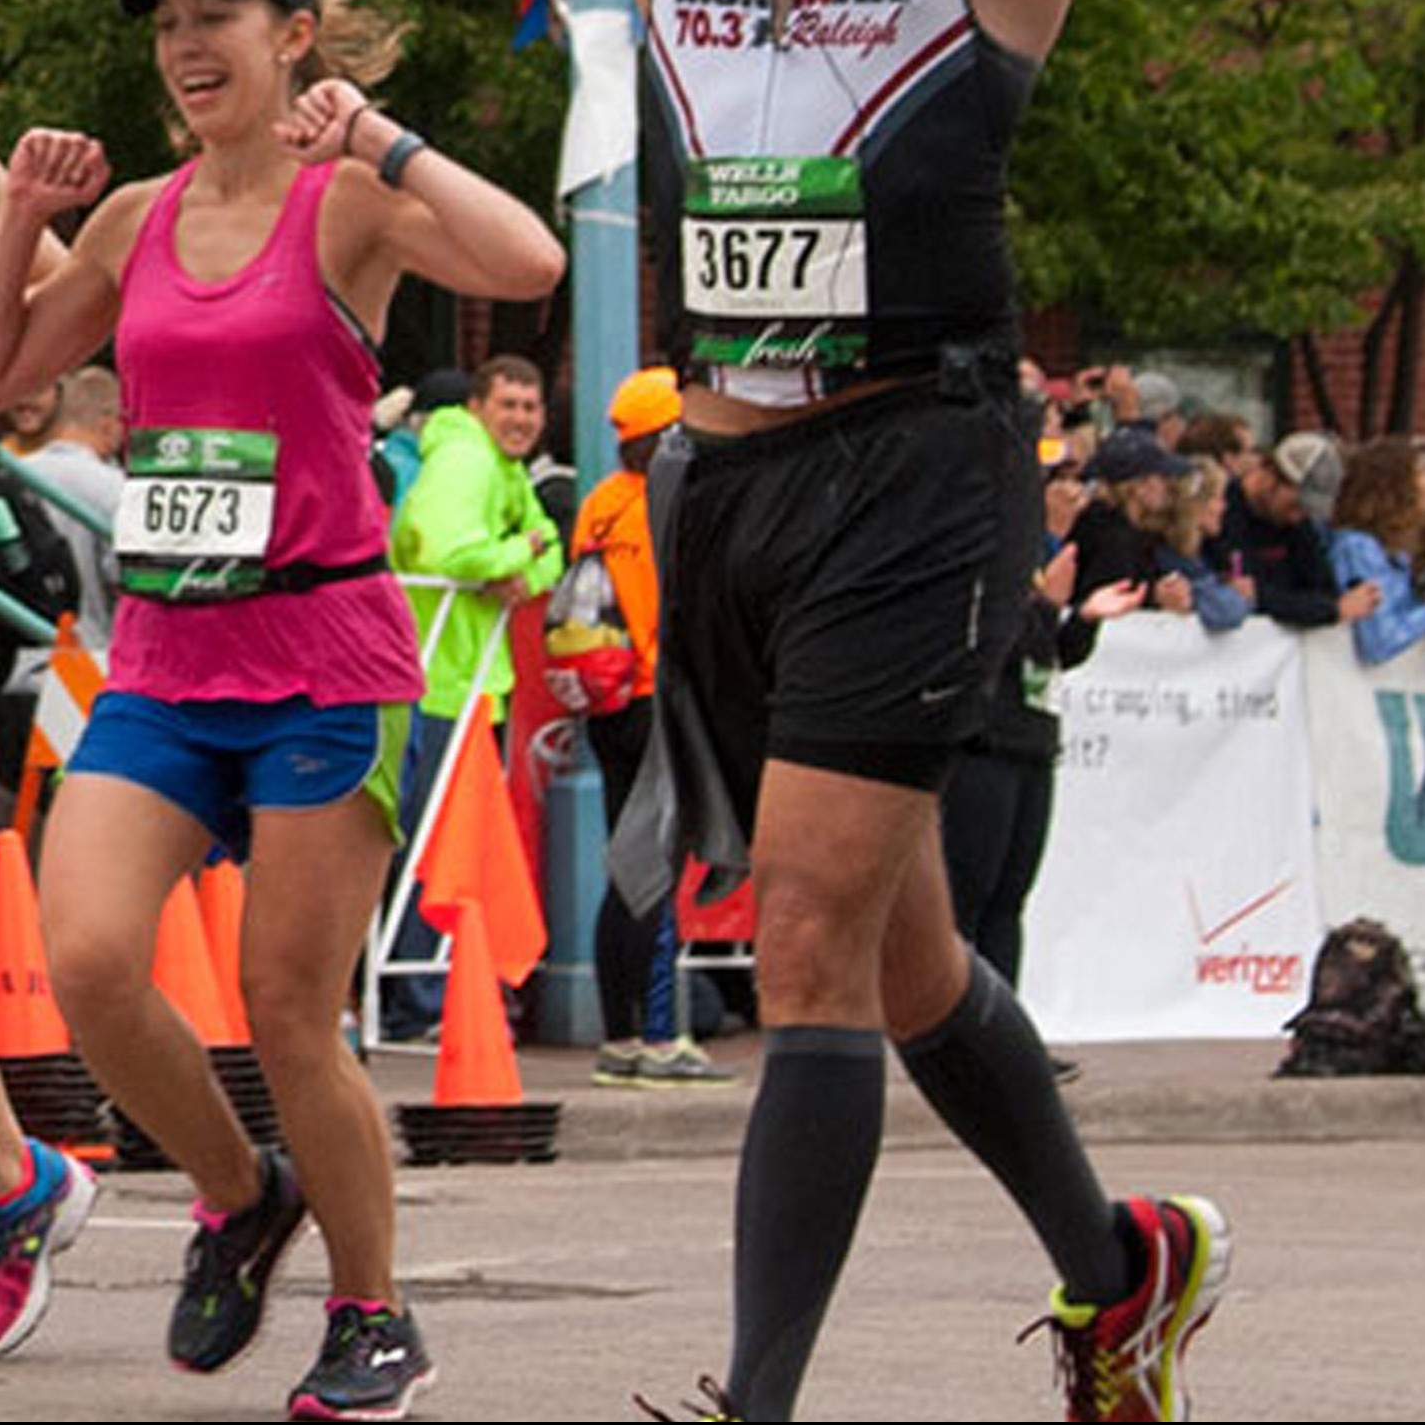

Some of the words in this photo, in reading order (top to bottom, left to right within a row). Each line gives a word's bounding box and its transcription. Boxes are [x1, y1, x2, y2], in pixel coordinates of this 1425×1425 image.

[674, 8, 745, 49] 70.3
[786, 5, 904, 61] Raleigh
[707, 162, 802, 183] WELLS
[709, 184, 801, 207] FARGO
[695, 227, 821, 291] 3677
[144, 483, 242, 536] 6673
[1195, 941, 1303, 994] verizon
